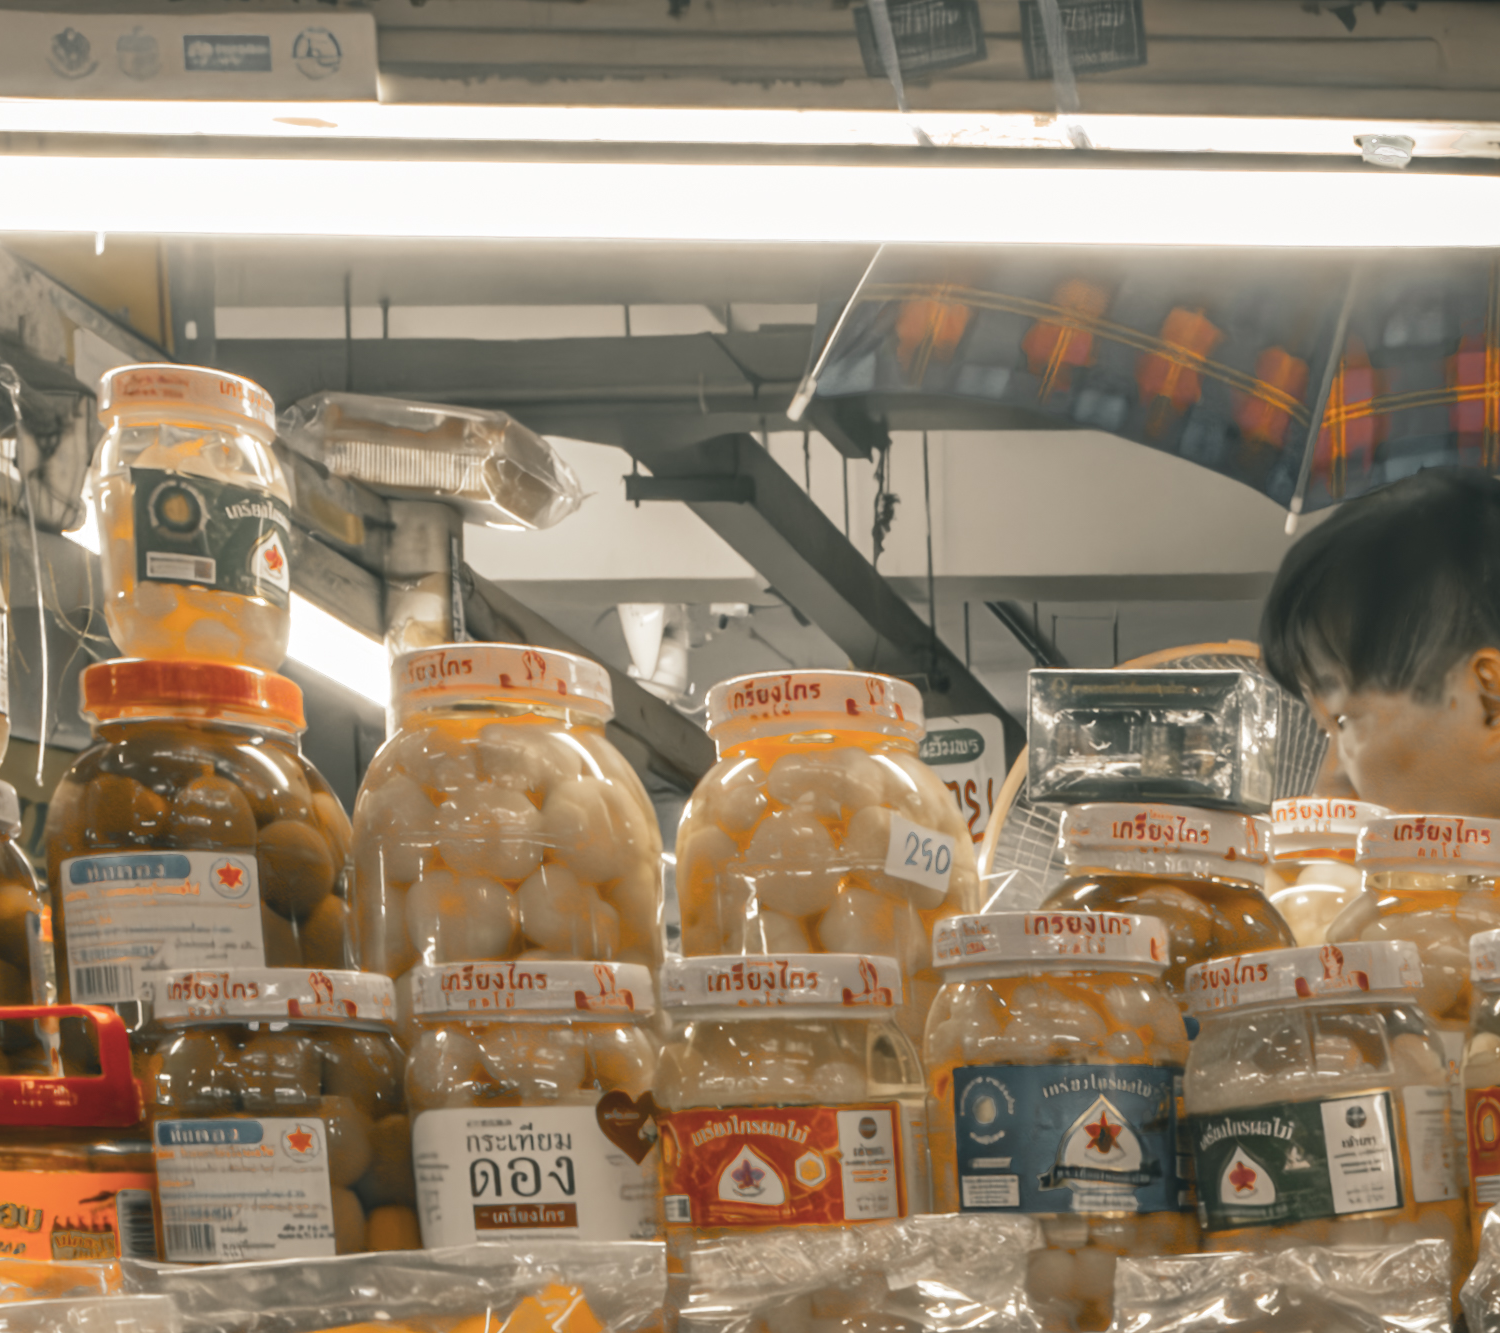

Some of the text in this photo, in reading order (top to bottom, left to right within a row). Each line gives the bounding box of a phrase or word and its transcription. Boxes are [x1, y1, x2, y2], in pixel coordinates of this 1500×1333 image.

[1275, 800, 1357, 824] กรียงไกร
[465, 1130, 573, 1154] กระเทียม
[469, 1153, 576, 1198] ดอง
